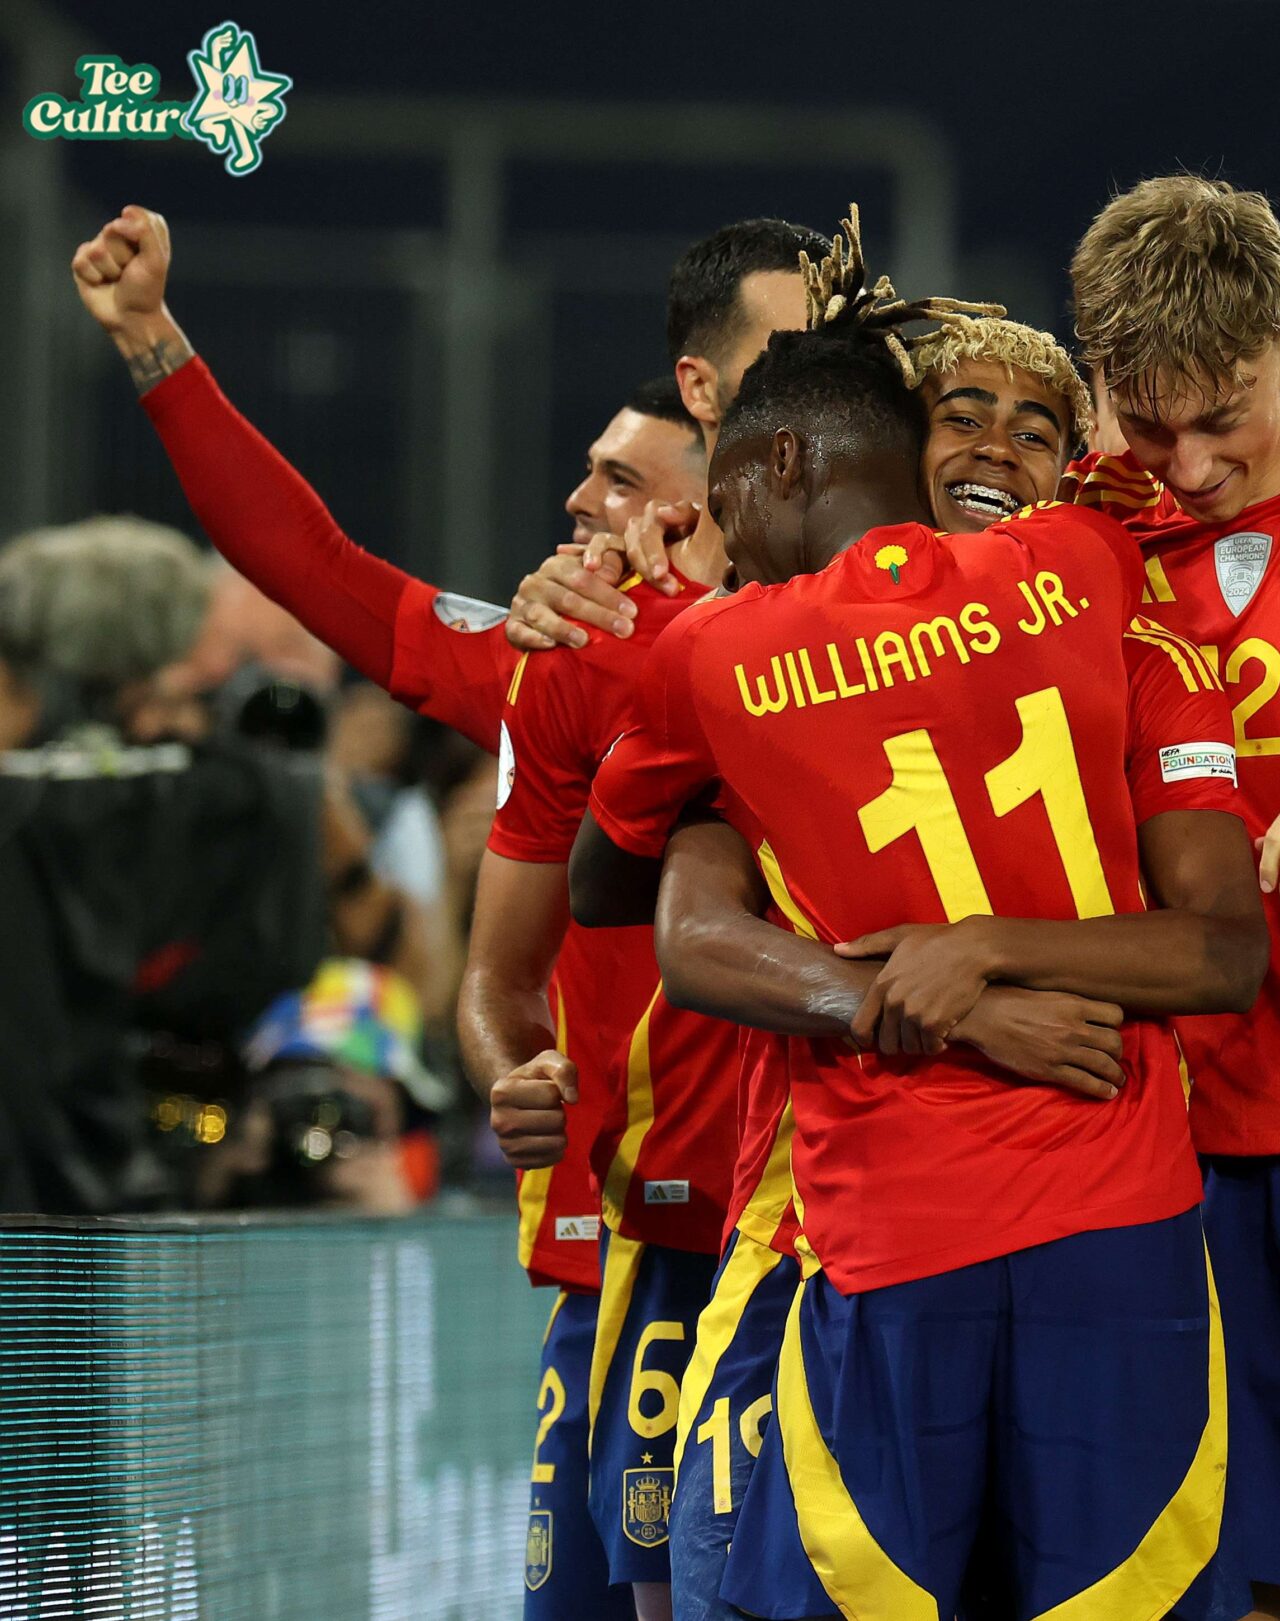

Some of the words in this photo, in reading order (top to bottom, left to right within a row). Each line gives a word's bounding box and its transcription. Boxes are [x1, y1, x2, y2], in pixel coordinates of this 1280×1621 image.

[1219, 552, 1265, 562] CHAMPIONS
[1220, 543, 1265, 555] EUROPEAN
[1228, 588, 1250, 597] 2024
[734, 602, 1001, 717] WILLIAMS
[1017, 570, 1091, 637] JR.
[1161, 748, 1180, 757] UEFA
[1163, 754, 1233, 770] FOUNDATION
[857, 686, 1116, 924] 11
[627, 1321, 685, 1439] 6
[530, 1366, 566, 1484] 2
